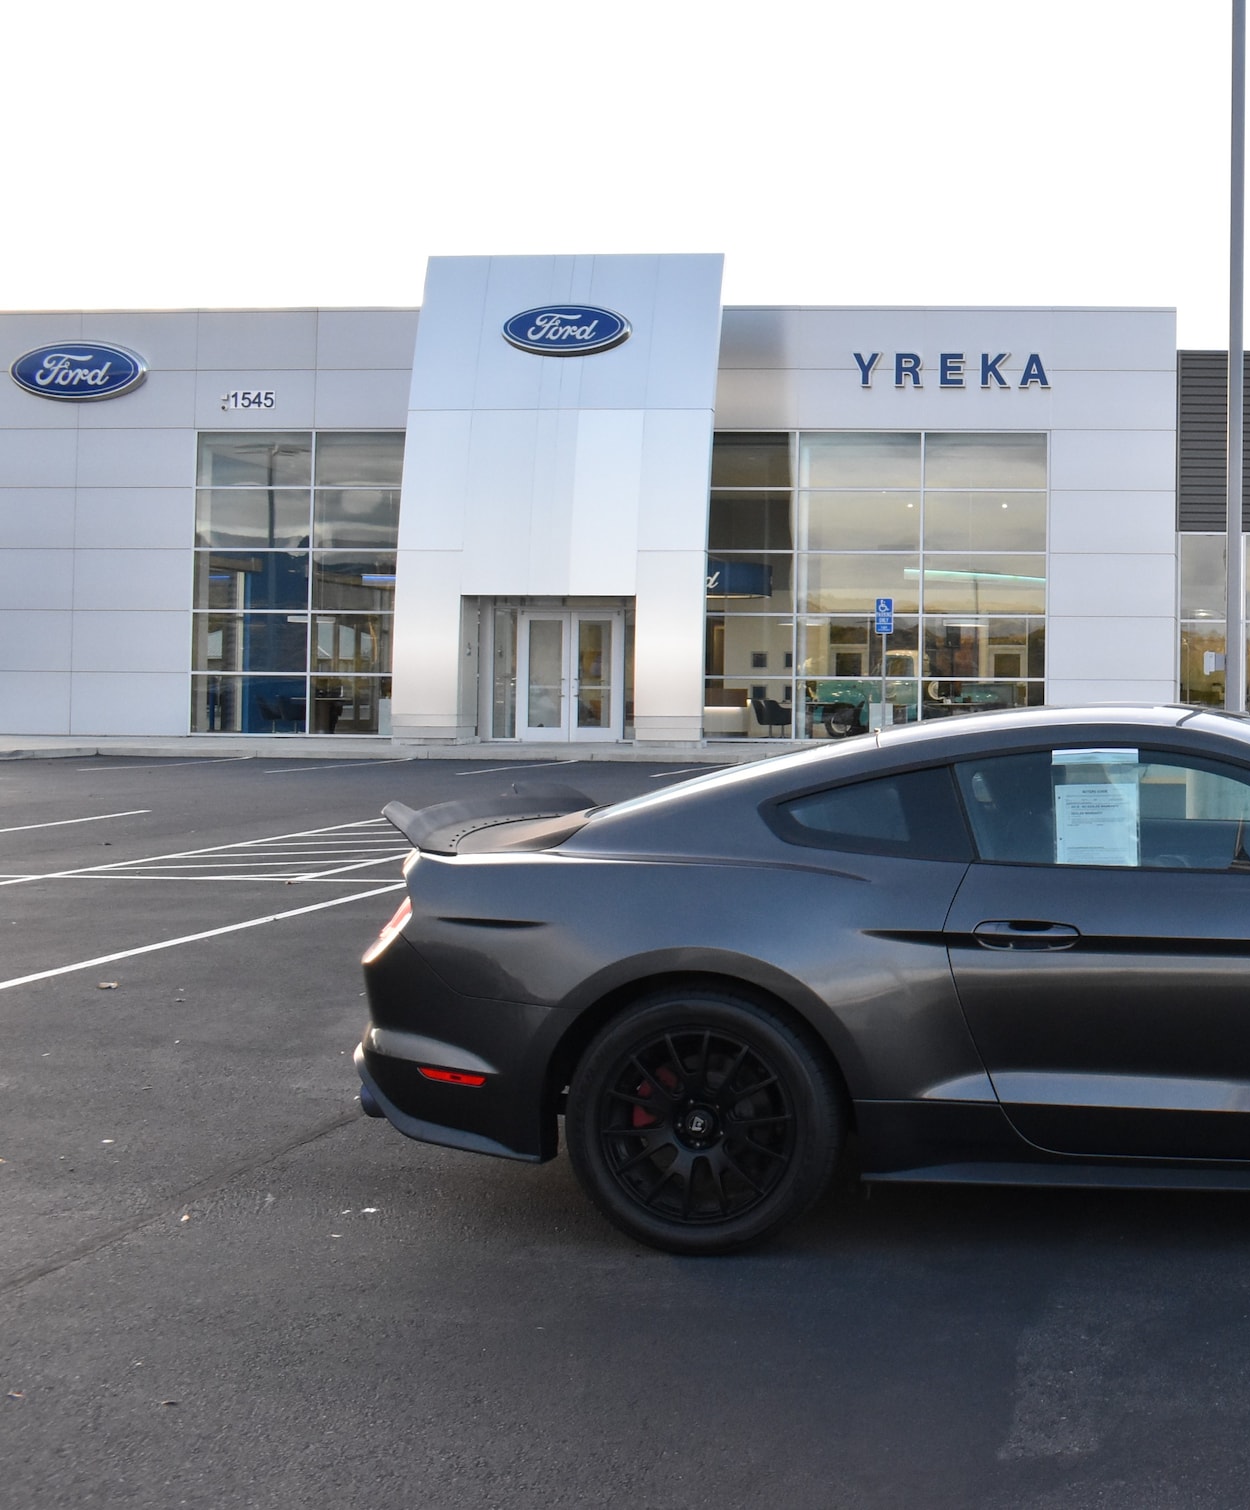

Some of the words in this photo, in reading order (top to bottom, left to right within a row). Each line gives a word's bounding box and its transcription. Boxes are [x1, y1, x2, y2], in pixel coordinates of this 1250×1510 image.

[527, 313, 599, 340] Ford
[35, 353, 112, 386] Ford
[852, 352, 1051, 388] YREKA
[231, 391, 275, 408] 1545
